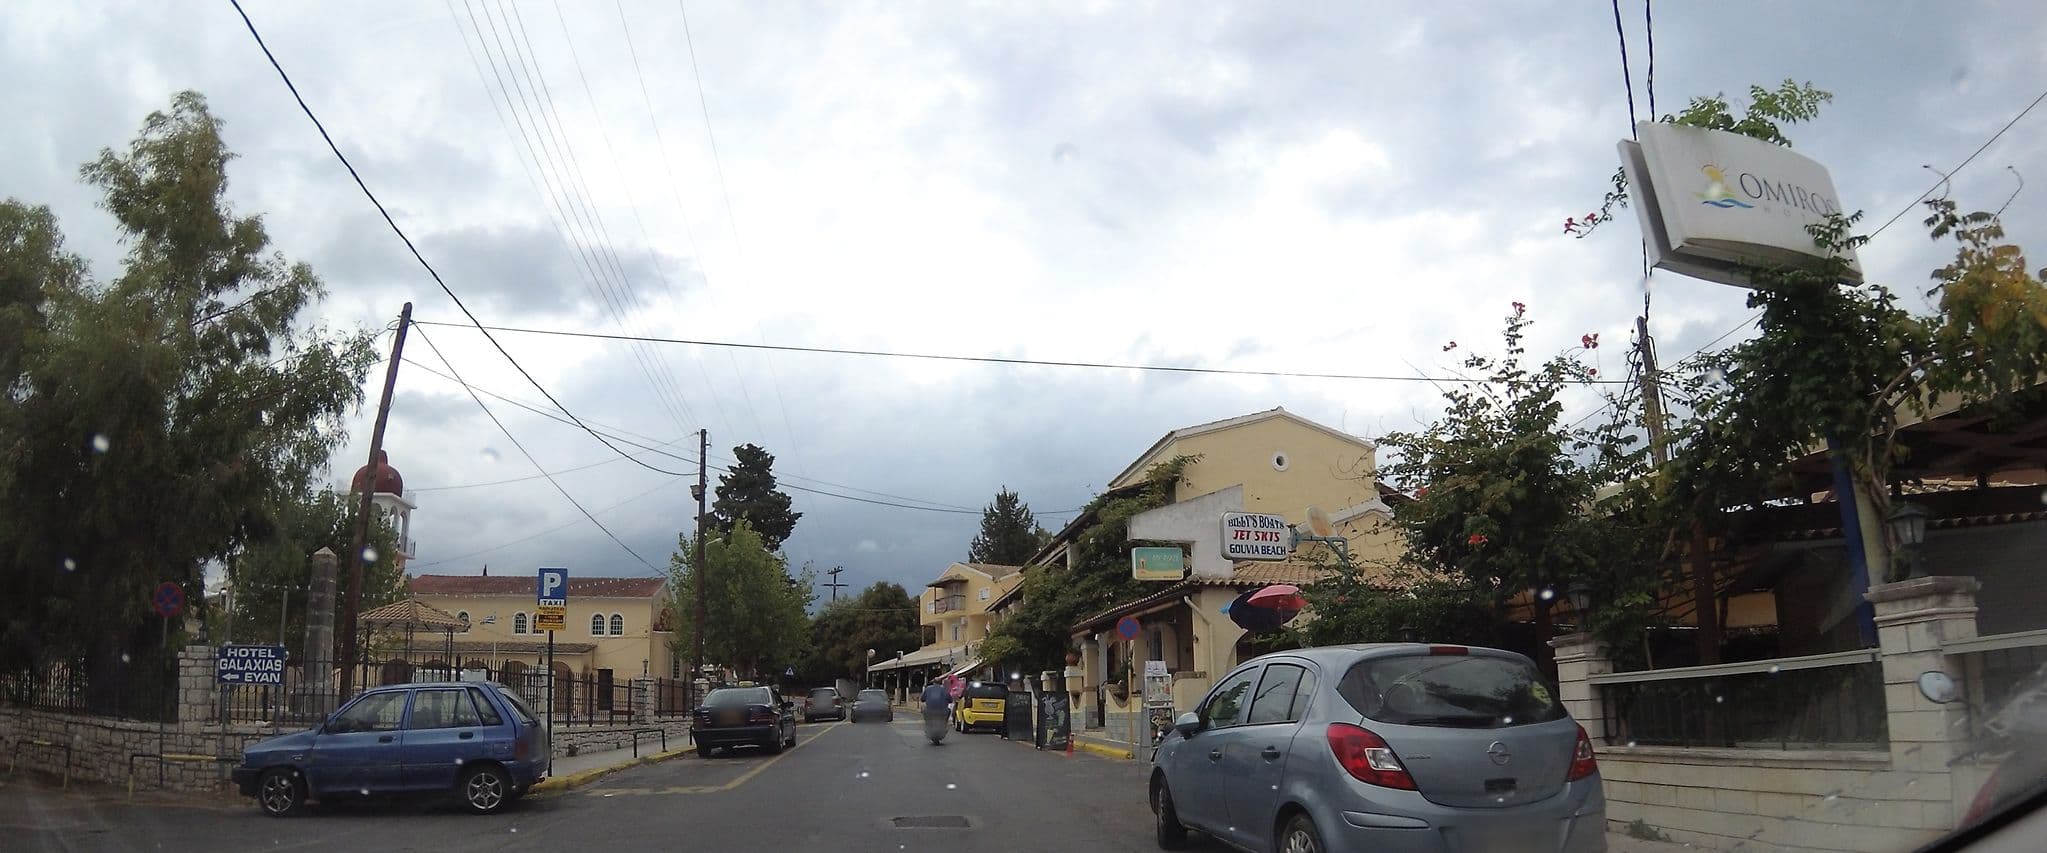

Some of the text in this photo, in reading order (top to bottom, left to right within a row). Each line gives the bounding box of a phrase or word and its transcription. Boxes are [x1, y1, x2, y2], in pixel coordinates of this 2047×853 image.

[1228, 514, 1285, 529] BILLY'S BOATS
[1233, 529, 1280, 542] JET SKIS
[1229, 544, 1286, 555] GOUVIA BEACH
[543, 572, 562, 596] P
[227, 648, 275, 658] HOTEL
[219, 658, 282, 671] GALAXIAS
[244, 672, 280, 683] EYAN
